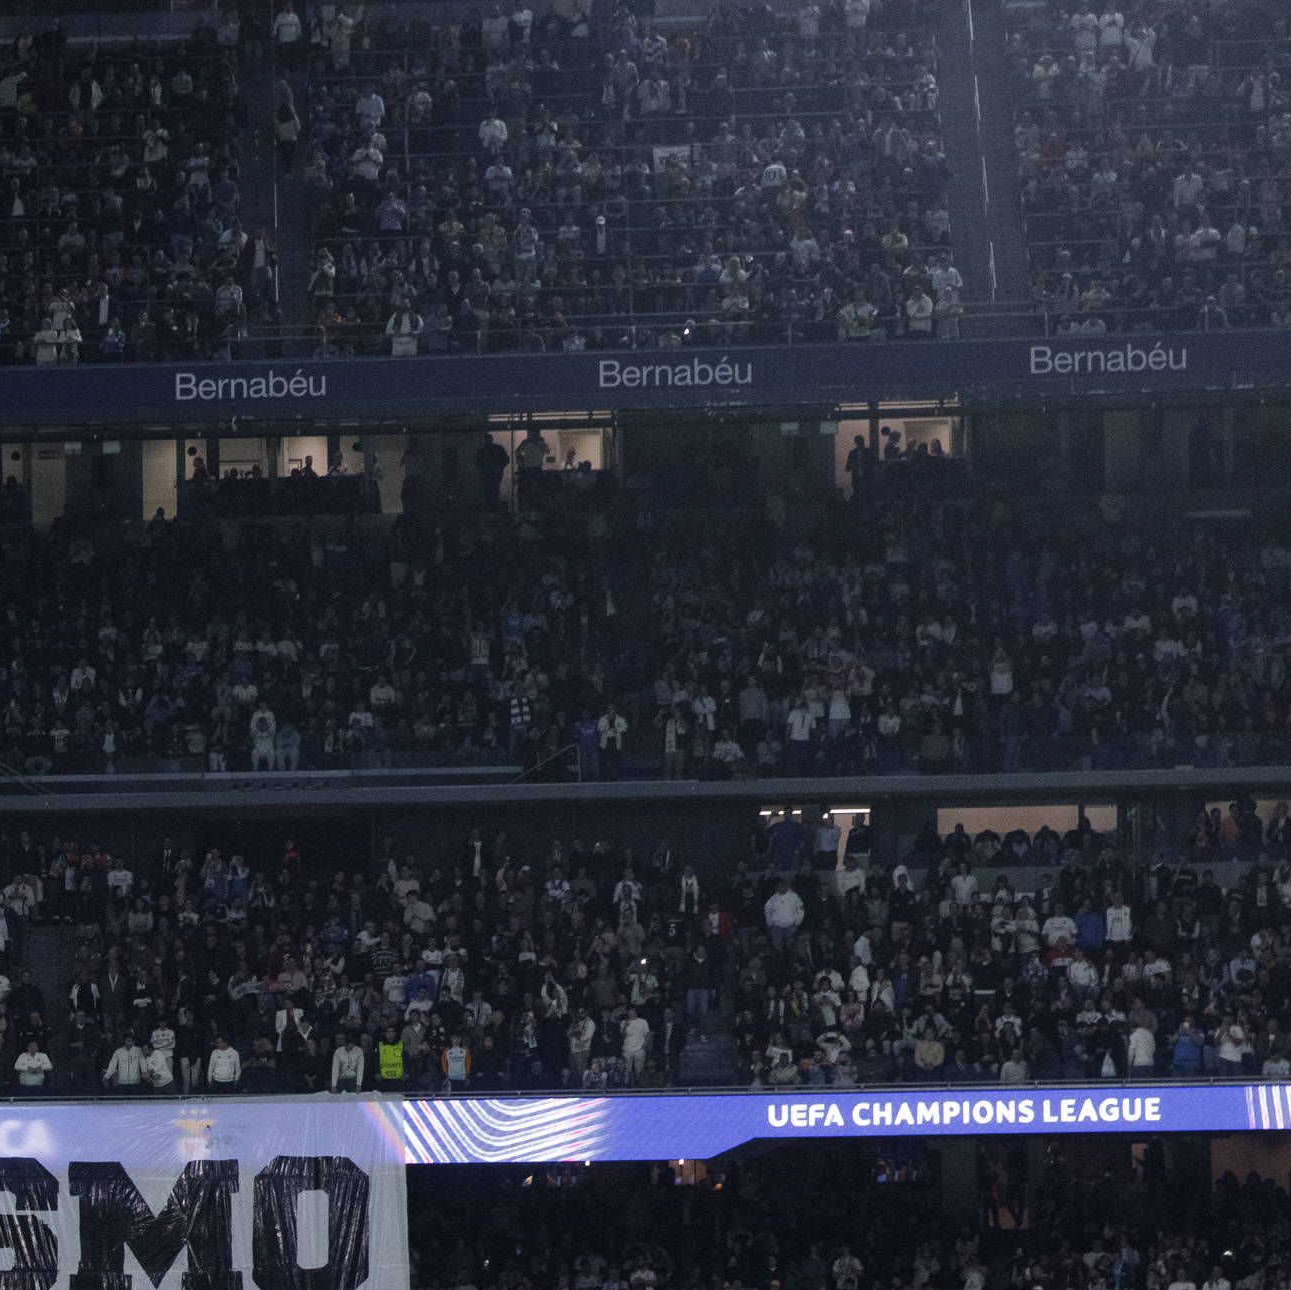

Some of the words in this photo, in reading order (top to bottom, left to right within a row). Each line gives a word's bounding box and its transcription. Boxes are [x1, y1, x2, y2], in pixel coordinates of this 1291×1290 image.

[599, 357, 752, 387] Bernabéu
[1030, 342, 1187, 374] Bernabéu
[175, 369, 327, 400] Bernabéu
[767, 1103, 844, 1128] UEFA
[852, 1100, 1035, 1126] CHAMPIONS
[1042, 1098, 1161, 1123] LEAGUE
